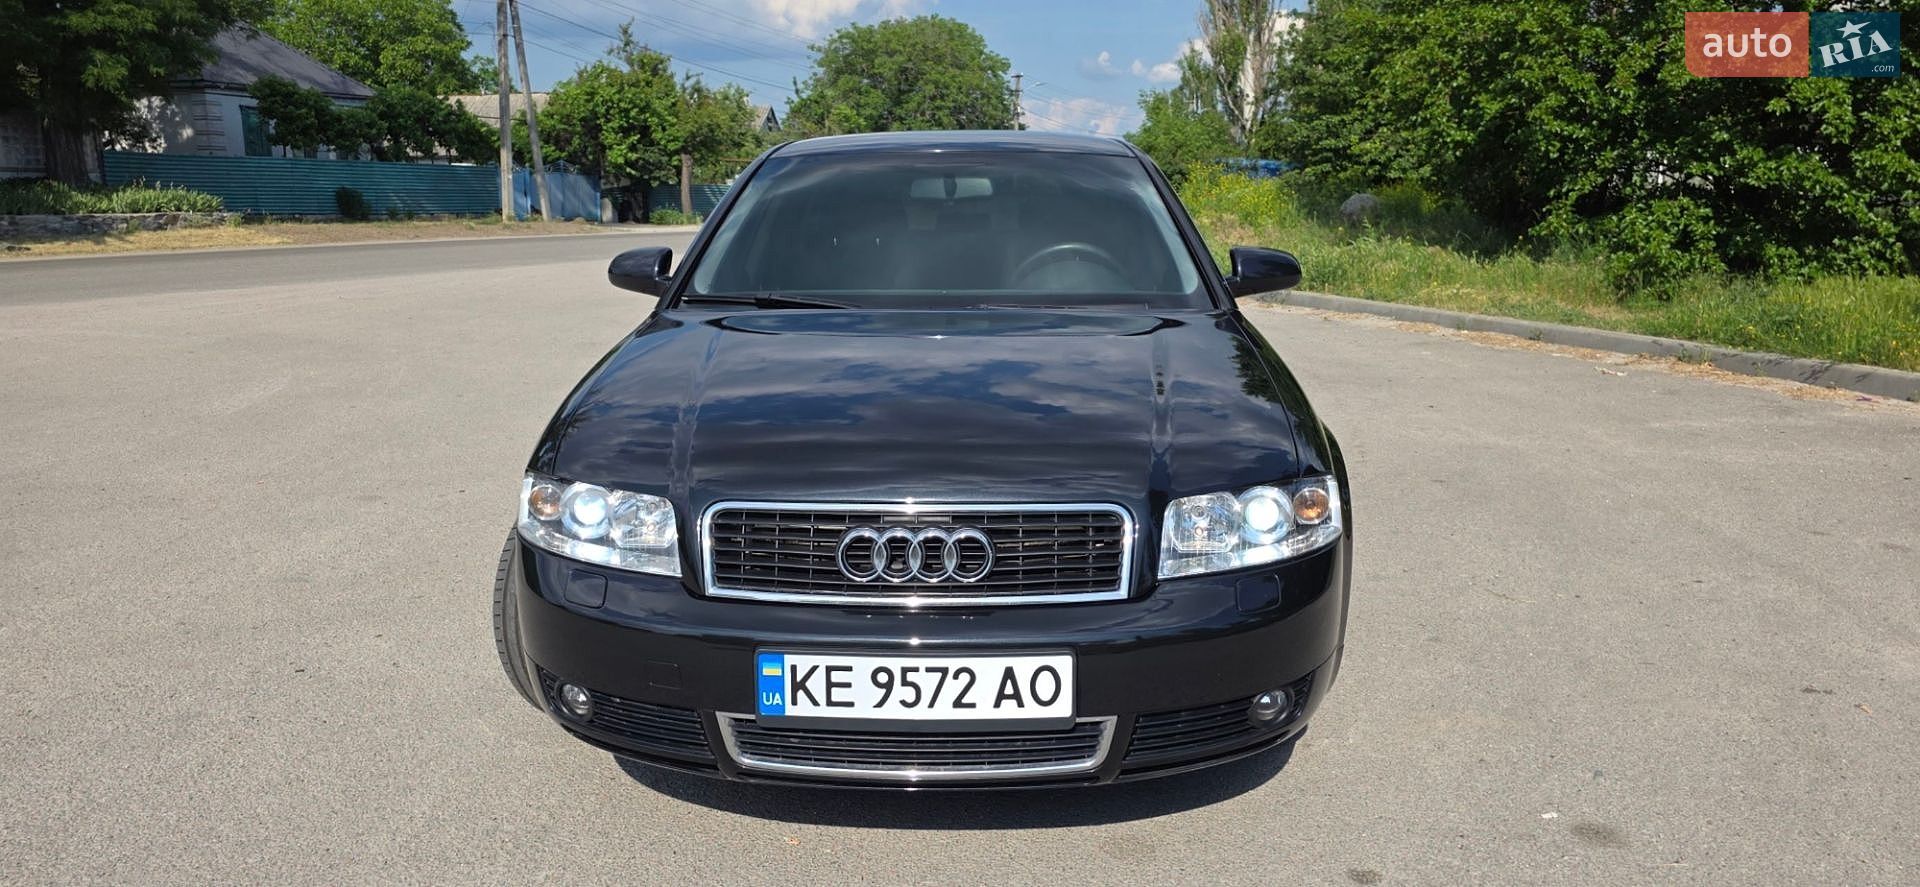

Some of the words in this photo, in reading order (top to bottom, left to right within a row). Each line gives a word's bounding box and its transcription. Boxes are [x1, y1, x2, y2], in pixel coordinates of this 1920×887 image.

[762, 692, 783, 706] UA
[790, 664, 855, 708] KE
[870, 665, 977, 709] 9572
[993, 664, 1062, 709] AO
